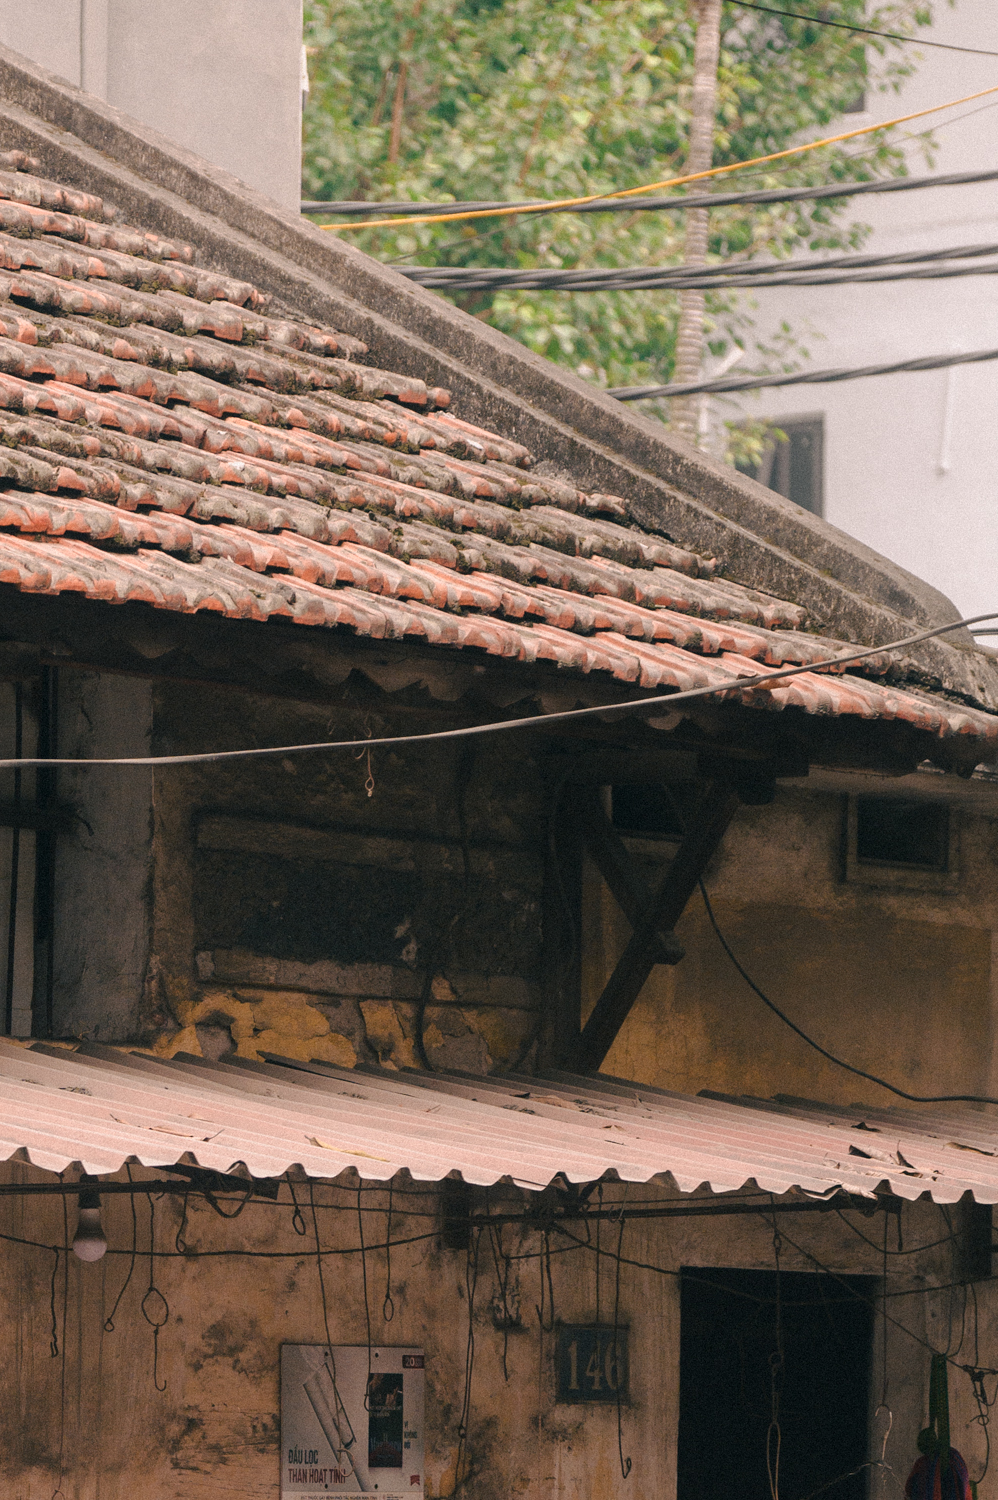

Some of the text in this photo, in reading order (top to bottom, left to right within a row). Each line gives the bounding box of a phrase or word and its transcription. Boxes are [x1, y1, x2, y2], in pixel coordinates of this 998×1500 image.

[304, 1449, 318, 1467] LỌC
[288, 1468, 307, 1483] THAN
[329, 1466, 346, 1484] TÍNH
